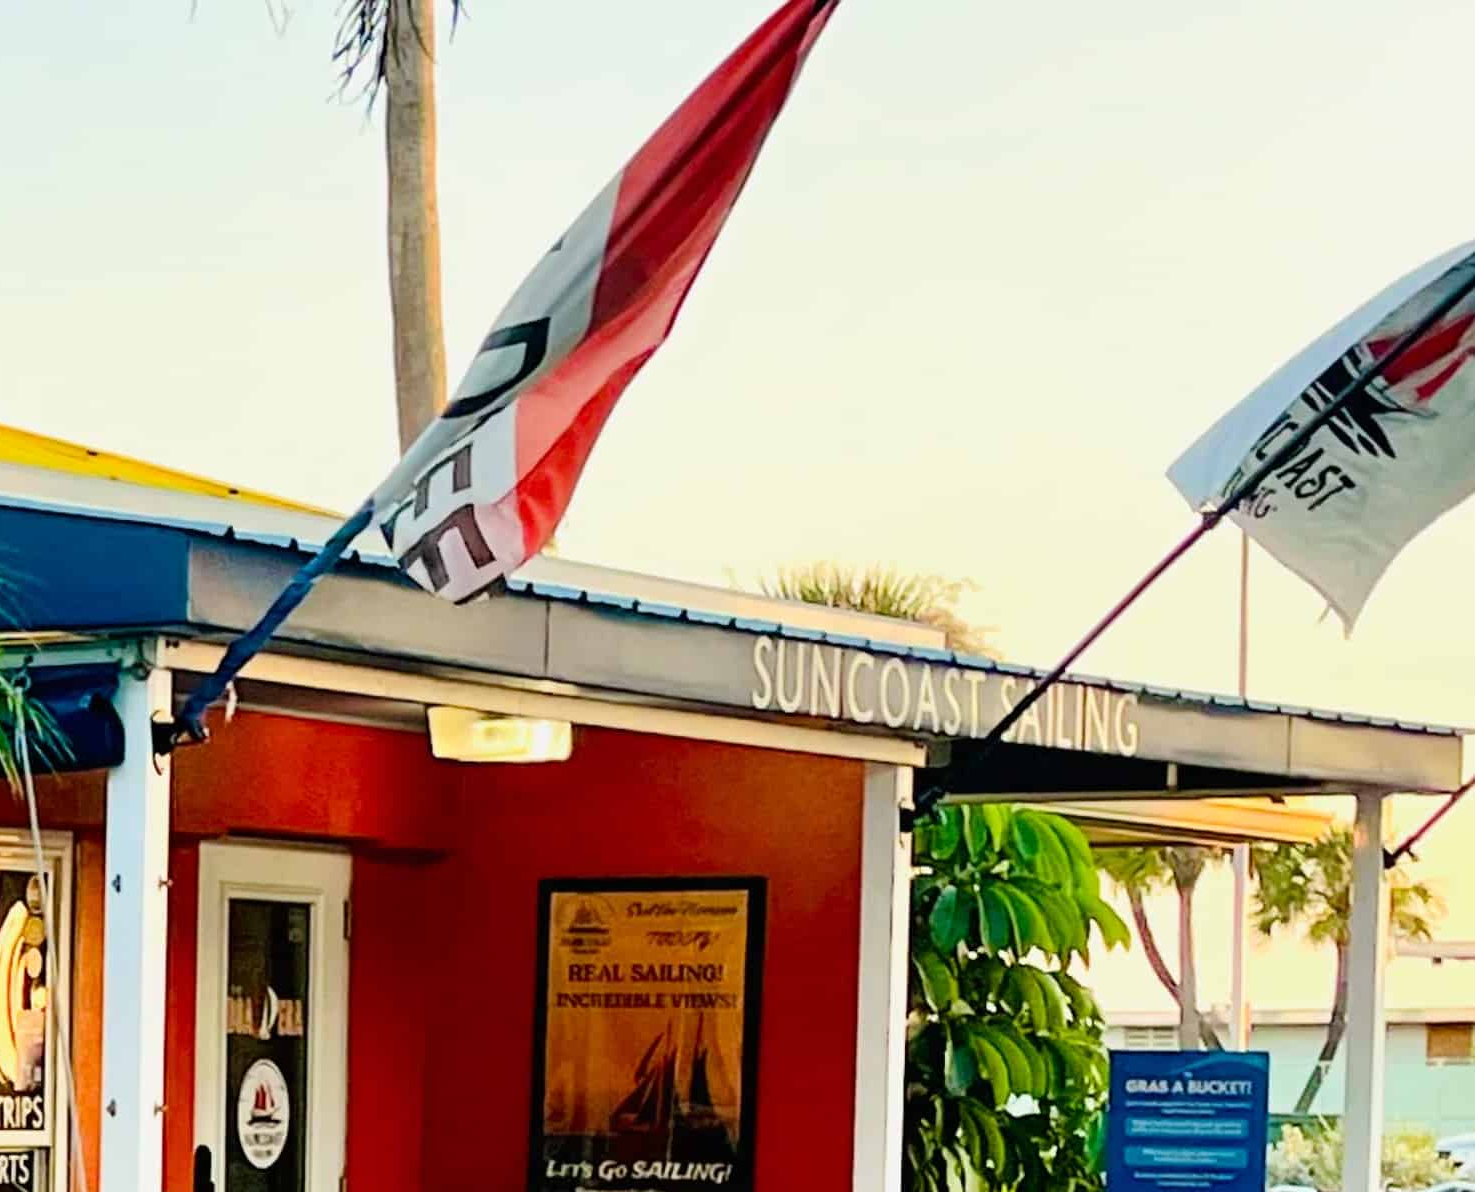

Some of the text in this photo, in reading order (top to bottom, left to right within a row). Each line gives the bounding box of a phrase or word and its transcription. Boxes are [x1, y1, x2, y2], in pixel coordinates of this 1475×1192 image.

[752, 635, 1139, 757] SUNCOAST SAILING
[568, 963, 725, 983] REAL SAILING!
[555, 991, 667, 1010] INCREDIBLE
[1171, 1080, 1184, 1095] A
[632, 1160, 733, 1184] SAILING!
